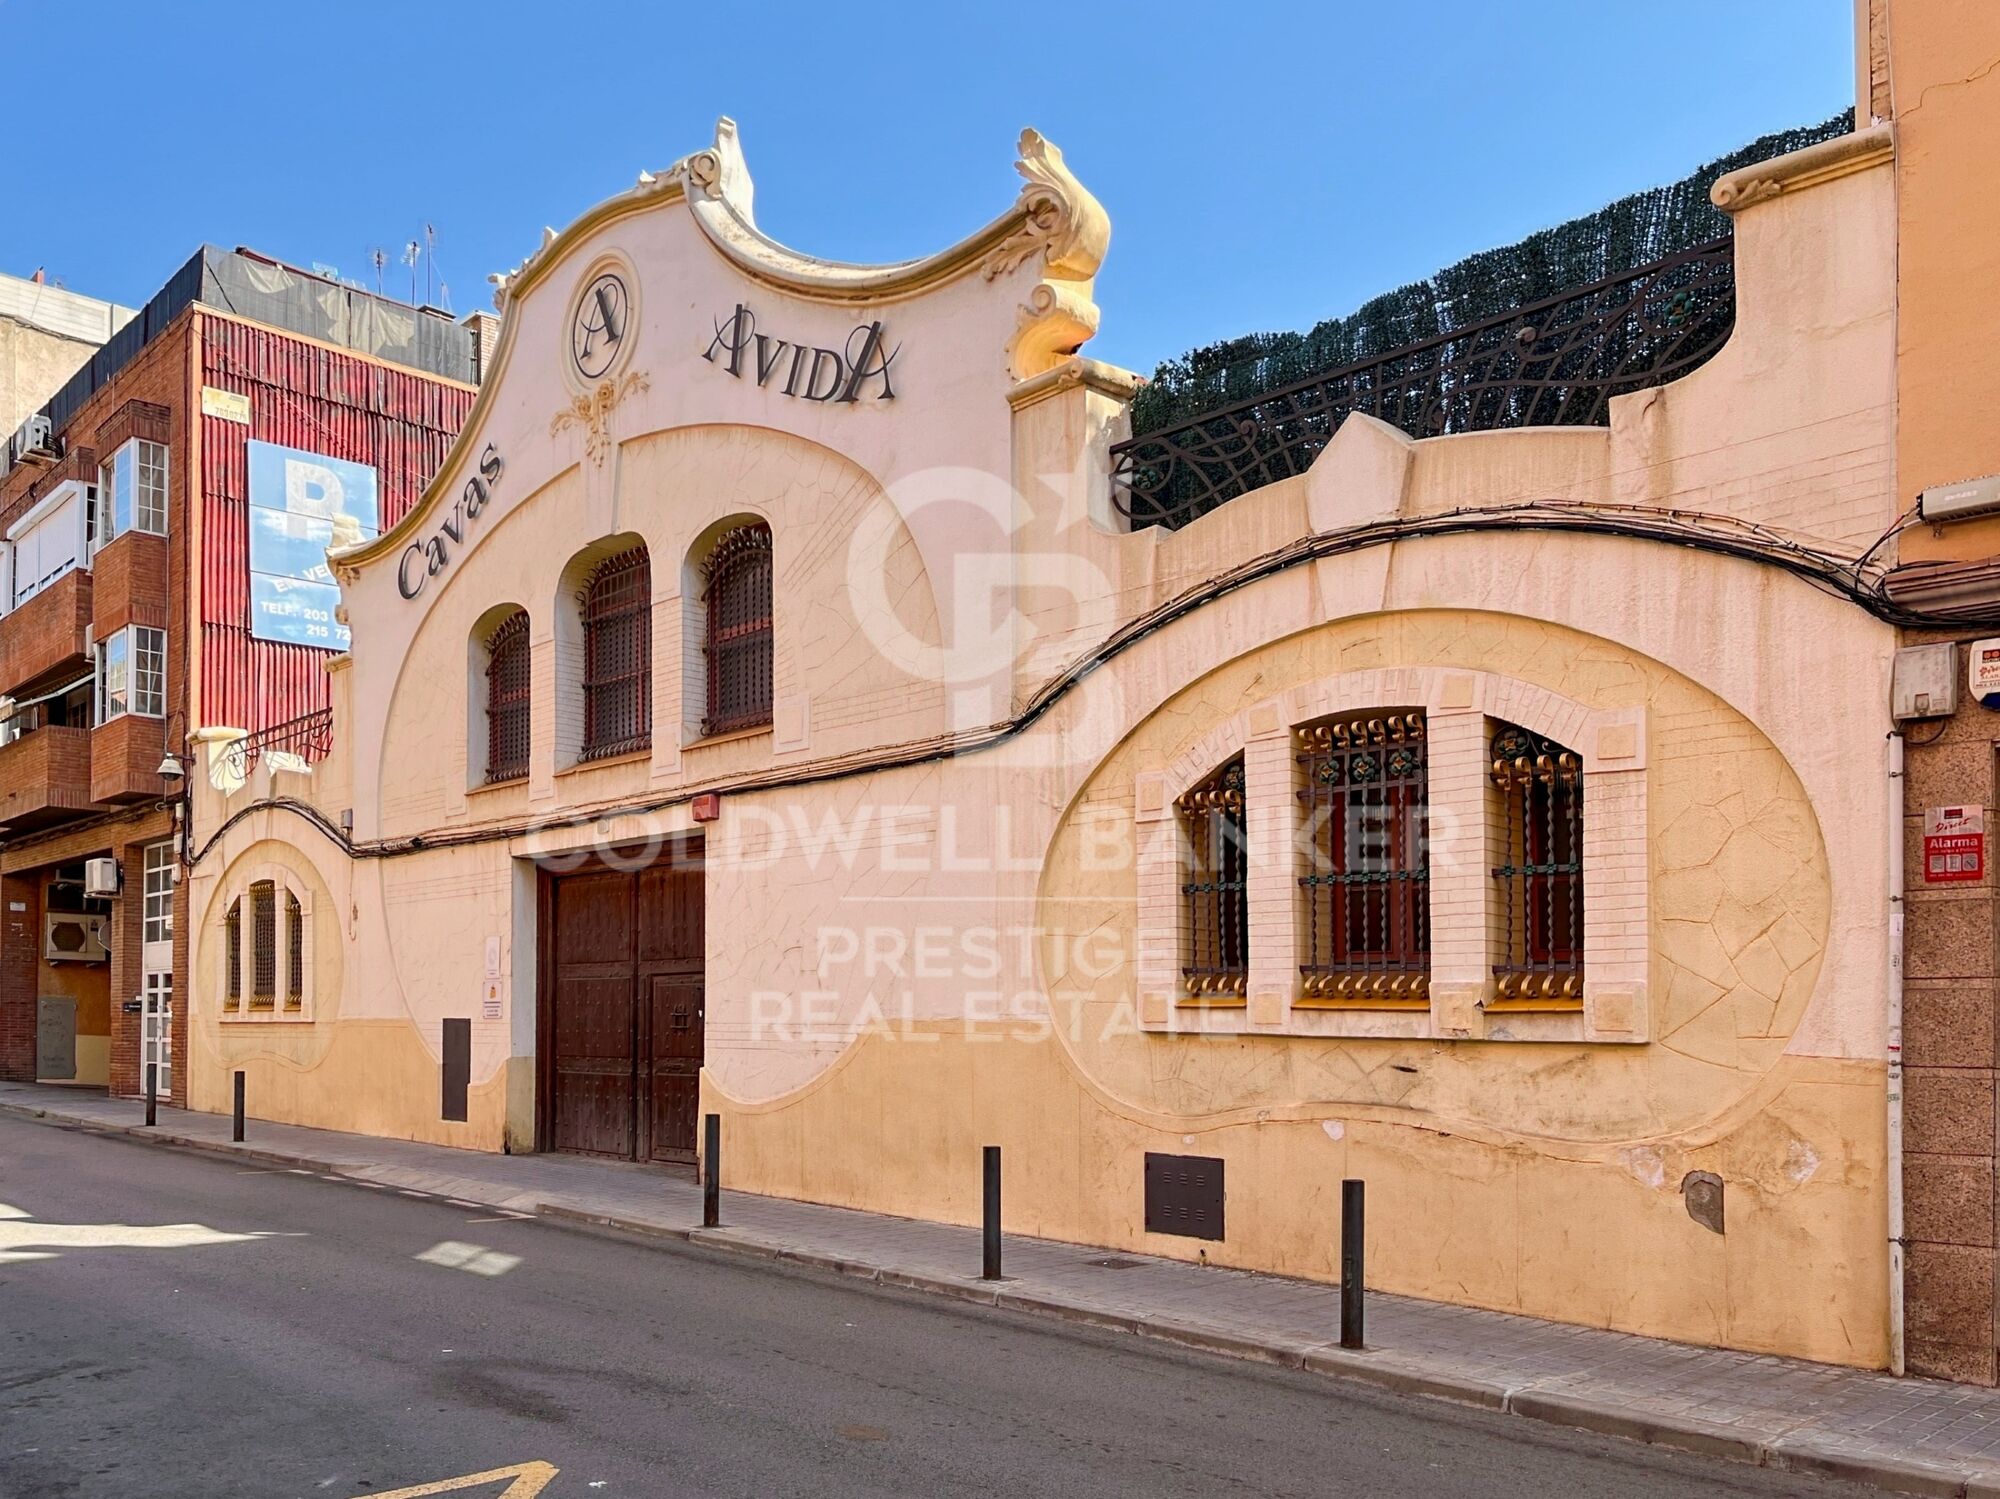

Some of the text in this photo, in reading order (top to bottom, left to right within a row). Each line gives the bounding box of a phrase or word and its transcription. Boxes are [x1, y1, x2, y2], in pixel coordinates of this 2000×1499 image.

[285, 458, 345, 539] P
[398, 442, 501, 600] Cavas
[303, 609, 329, 621] 203
[306, 624, 329, 637] 215
[1930, 837, 1978, 849] Alarma
